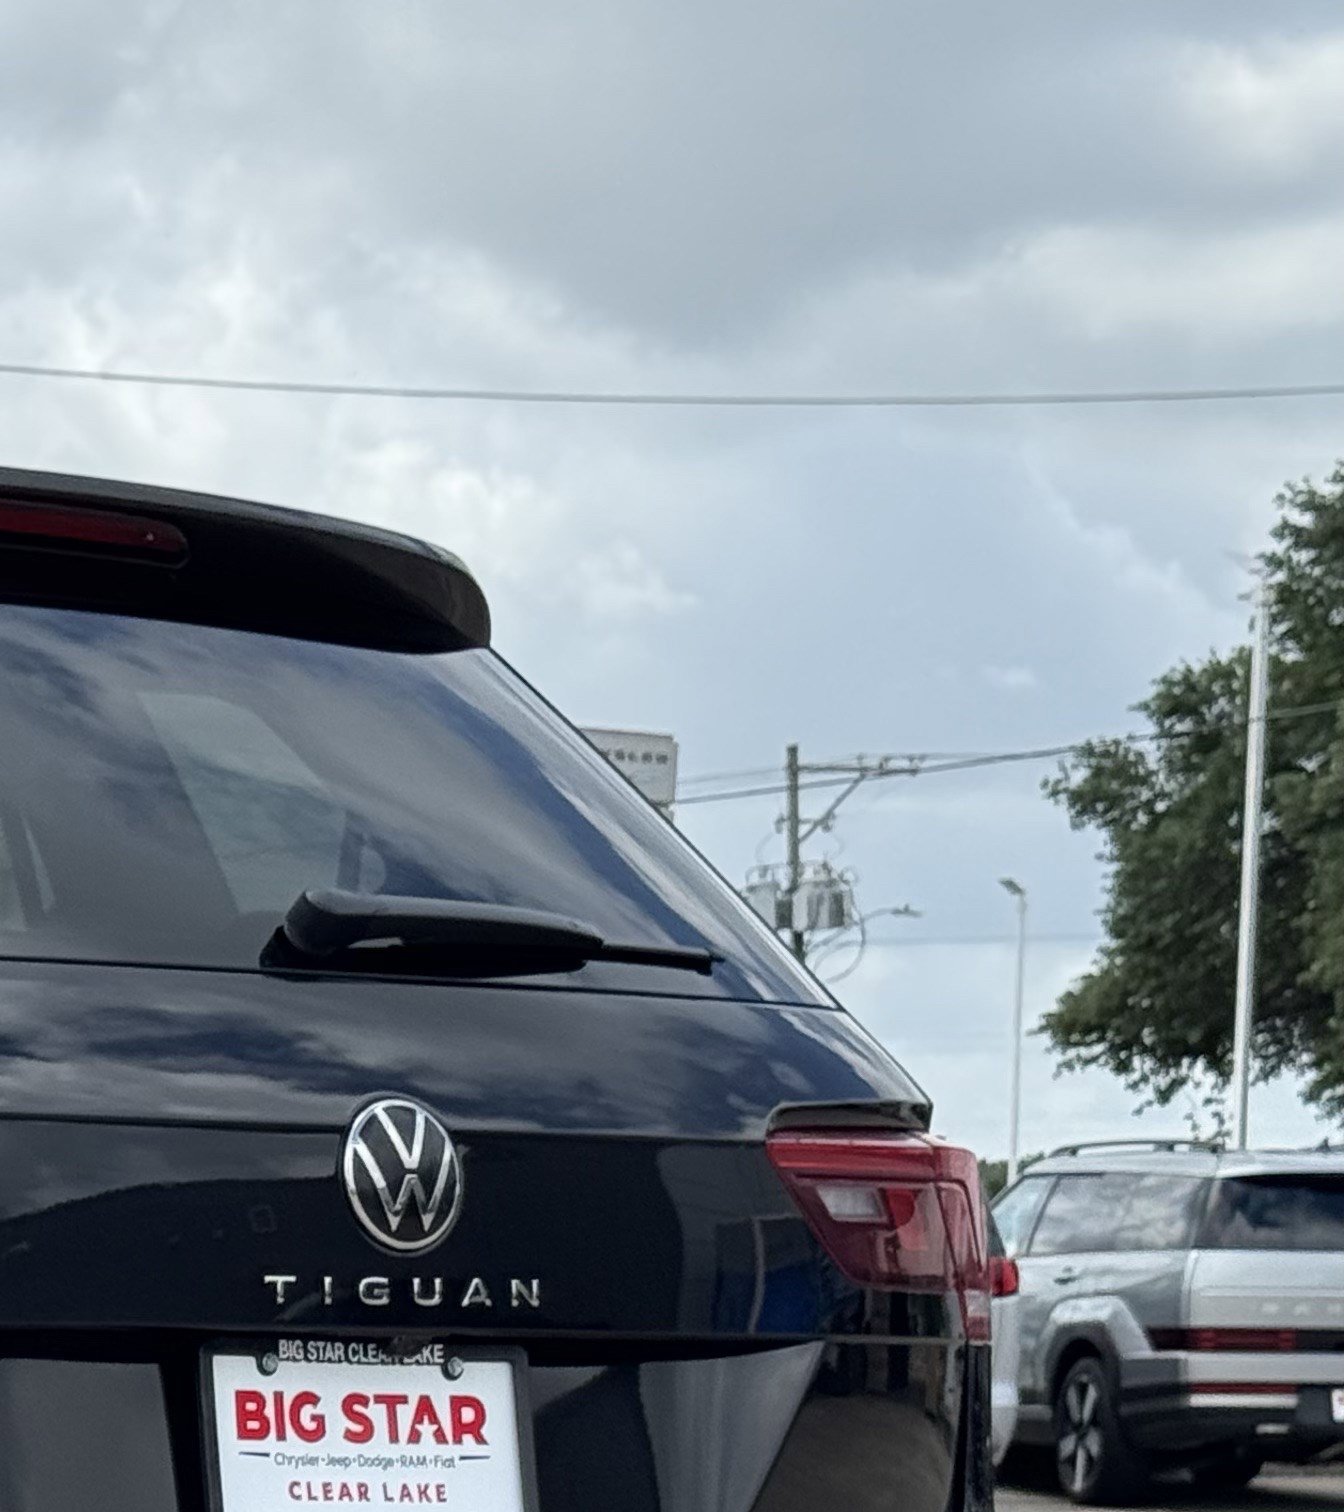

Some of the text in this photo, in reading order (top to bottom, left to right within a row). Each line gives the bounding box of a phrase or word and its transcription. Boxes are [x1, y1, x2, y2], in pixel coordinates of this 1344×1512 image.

[264, 1275, 540, 1307] TIGUAN
[278, 1339, 304, 1360] BIG
[307, 1341, 345, 1361] STAR
[234, 1389, 489, 1445] BIG STAR
[288, 1480, 448, 1503] CLEAR LAKE
